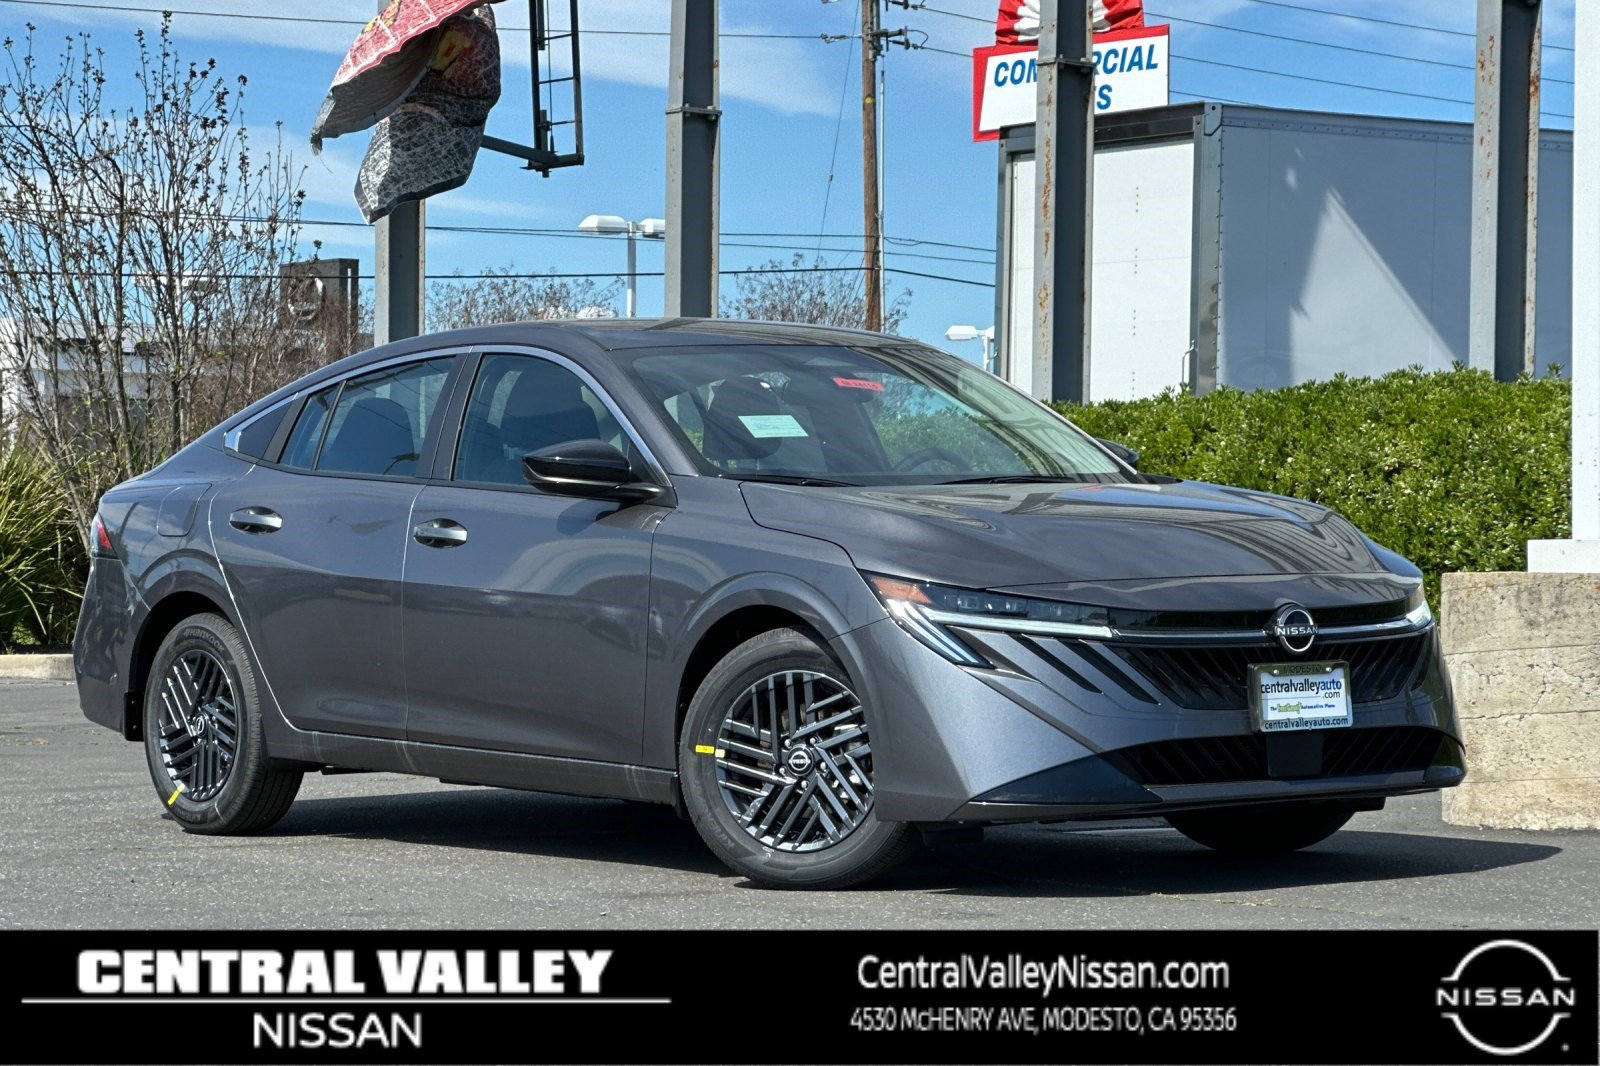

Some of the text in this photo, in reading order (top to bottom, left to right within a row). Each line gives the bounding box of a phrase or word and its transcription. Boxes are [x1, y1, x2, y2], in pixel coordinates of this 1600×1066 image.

[994, 44, 1159, 87] COMRCIAL
[1277, 626, 1318, 636] NISSAN
[1261, 679, 1342, 694] centralvalleyauto
[1322, 691, 1341, 699] .com
[1264, 717, 1349, 730] centralvalleyauto.com
